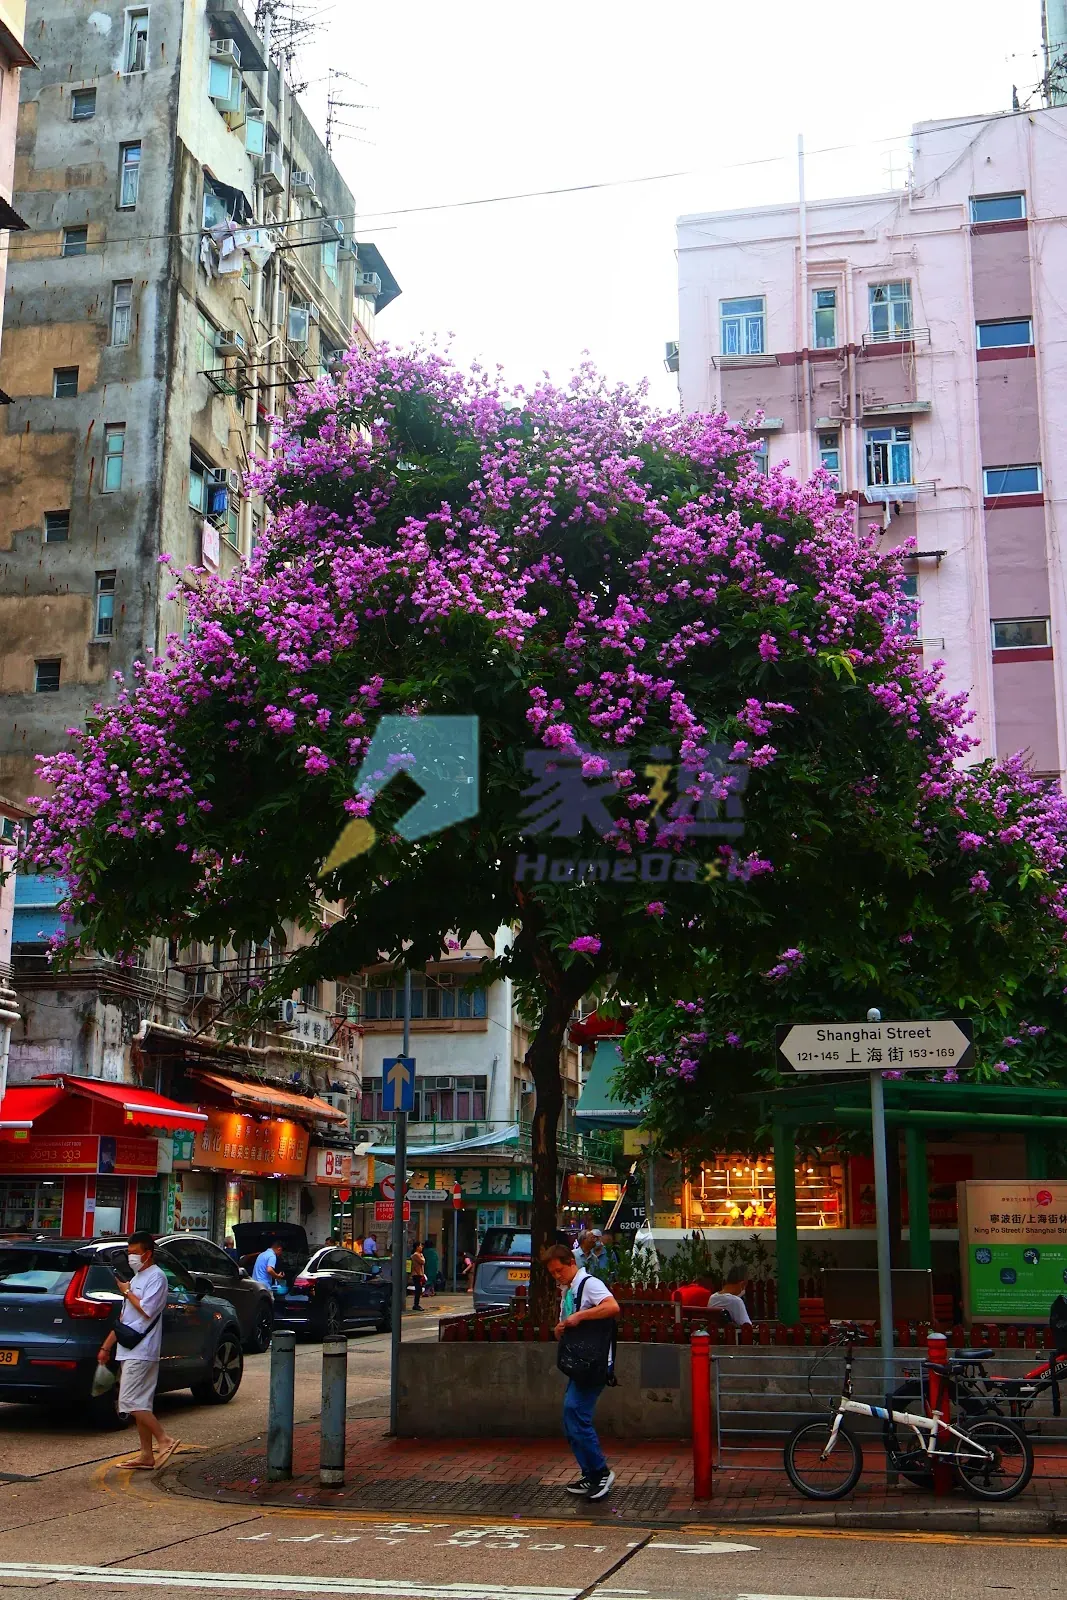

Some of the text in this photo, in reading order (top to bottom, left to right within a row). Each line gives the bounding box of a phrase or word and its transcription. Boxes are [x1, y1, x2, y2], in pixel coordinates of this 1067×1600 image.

[816, 1026, 932, 1042] Shanghai Street
[845, 1047, 904, 1065] 上海街
[974, 1227, 990, 1236] Ning
[1025, 1227, 1057, 1236] Shanghai
[235, 1531, 608, 1554] LOOK LEFT
